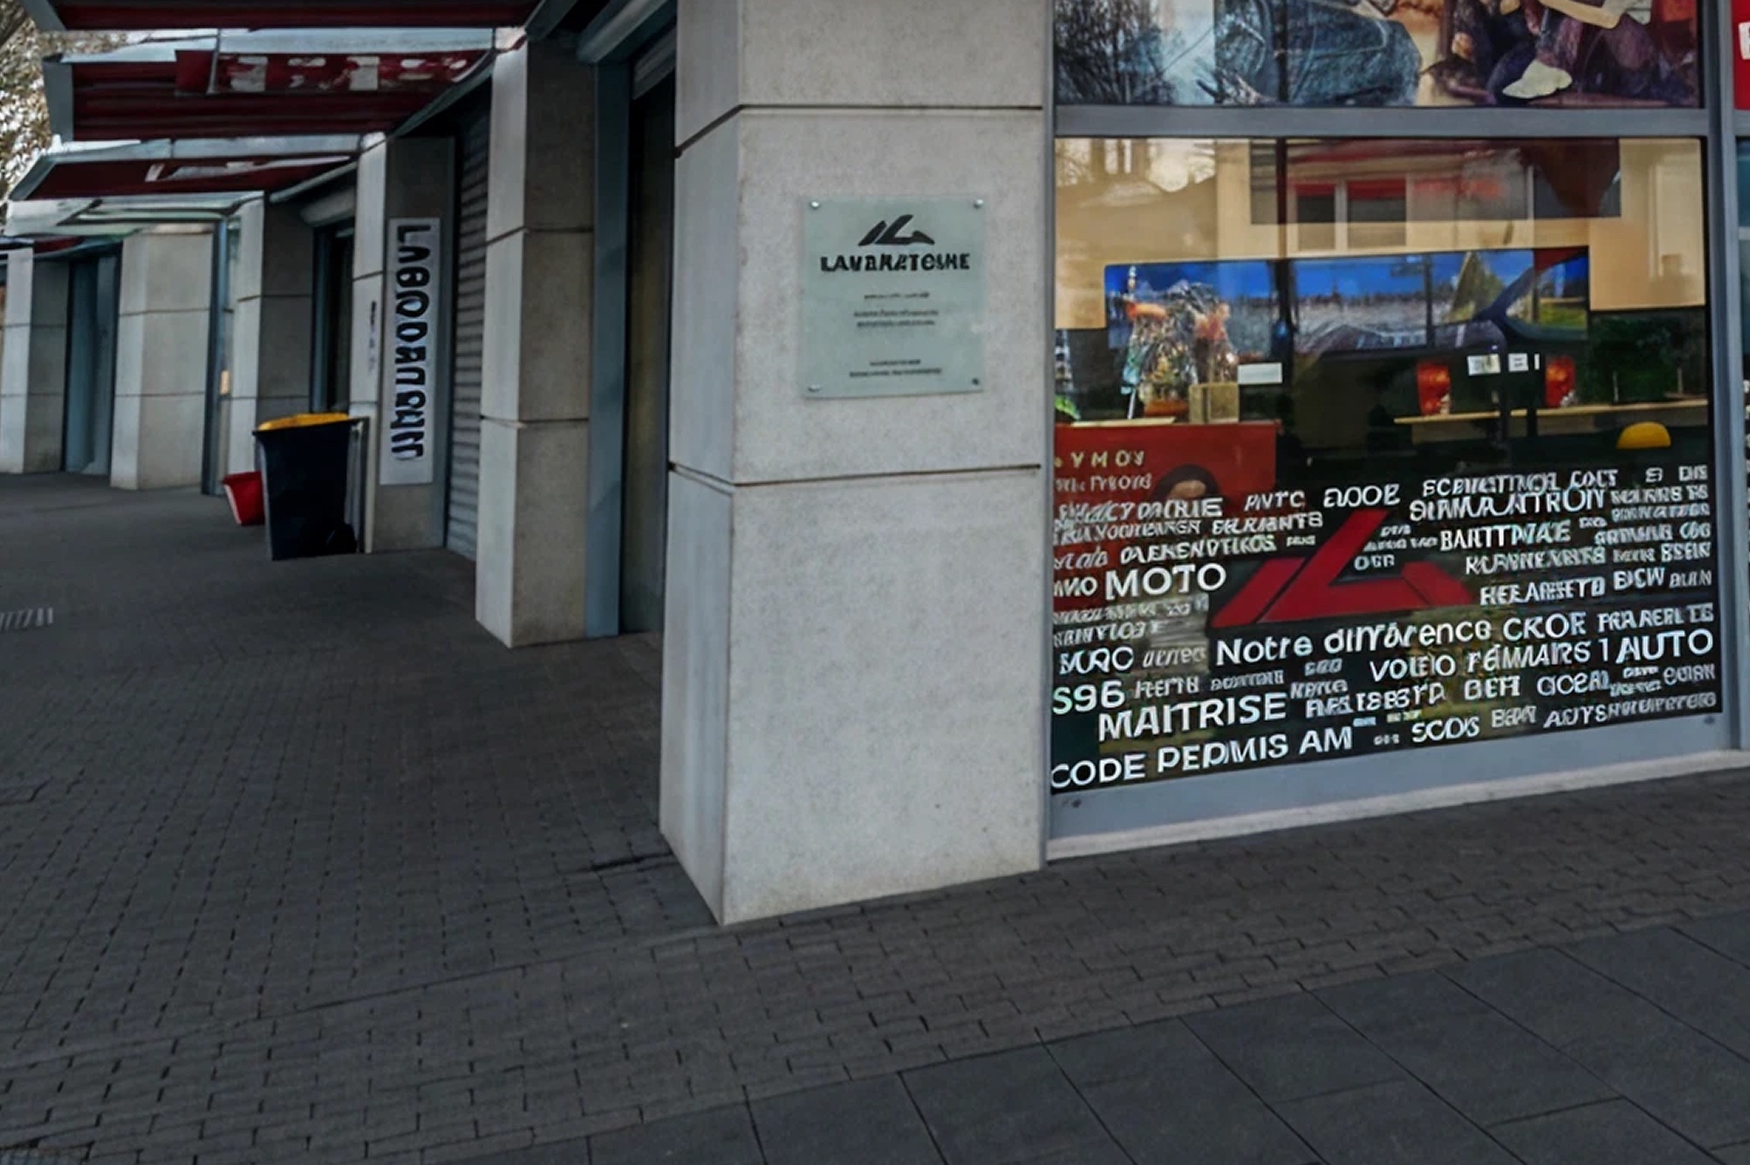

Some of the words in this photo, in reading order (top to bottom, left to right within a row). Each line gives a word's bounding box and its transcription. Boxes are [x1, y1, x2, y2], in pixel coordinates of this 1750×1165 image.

[1104, 563, 1227, 601] MOTO
[1216, 634, 1313, 667] Notre
[1616, 628, 1714, 665] AUTO
[1098, 692, 1288, 742] MAITRISE
[1051, 753, 1147, 789] CODE
[1298, 725, 1353, 755] AM
